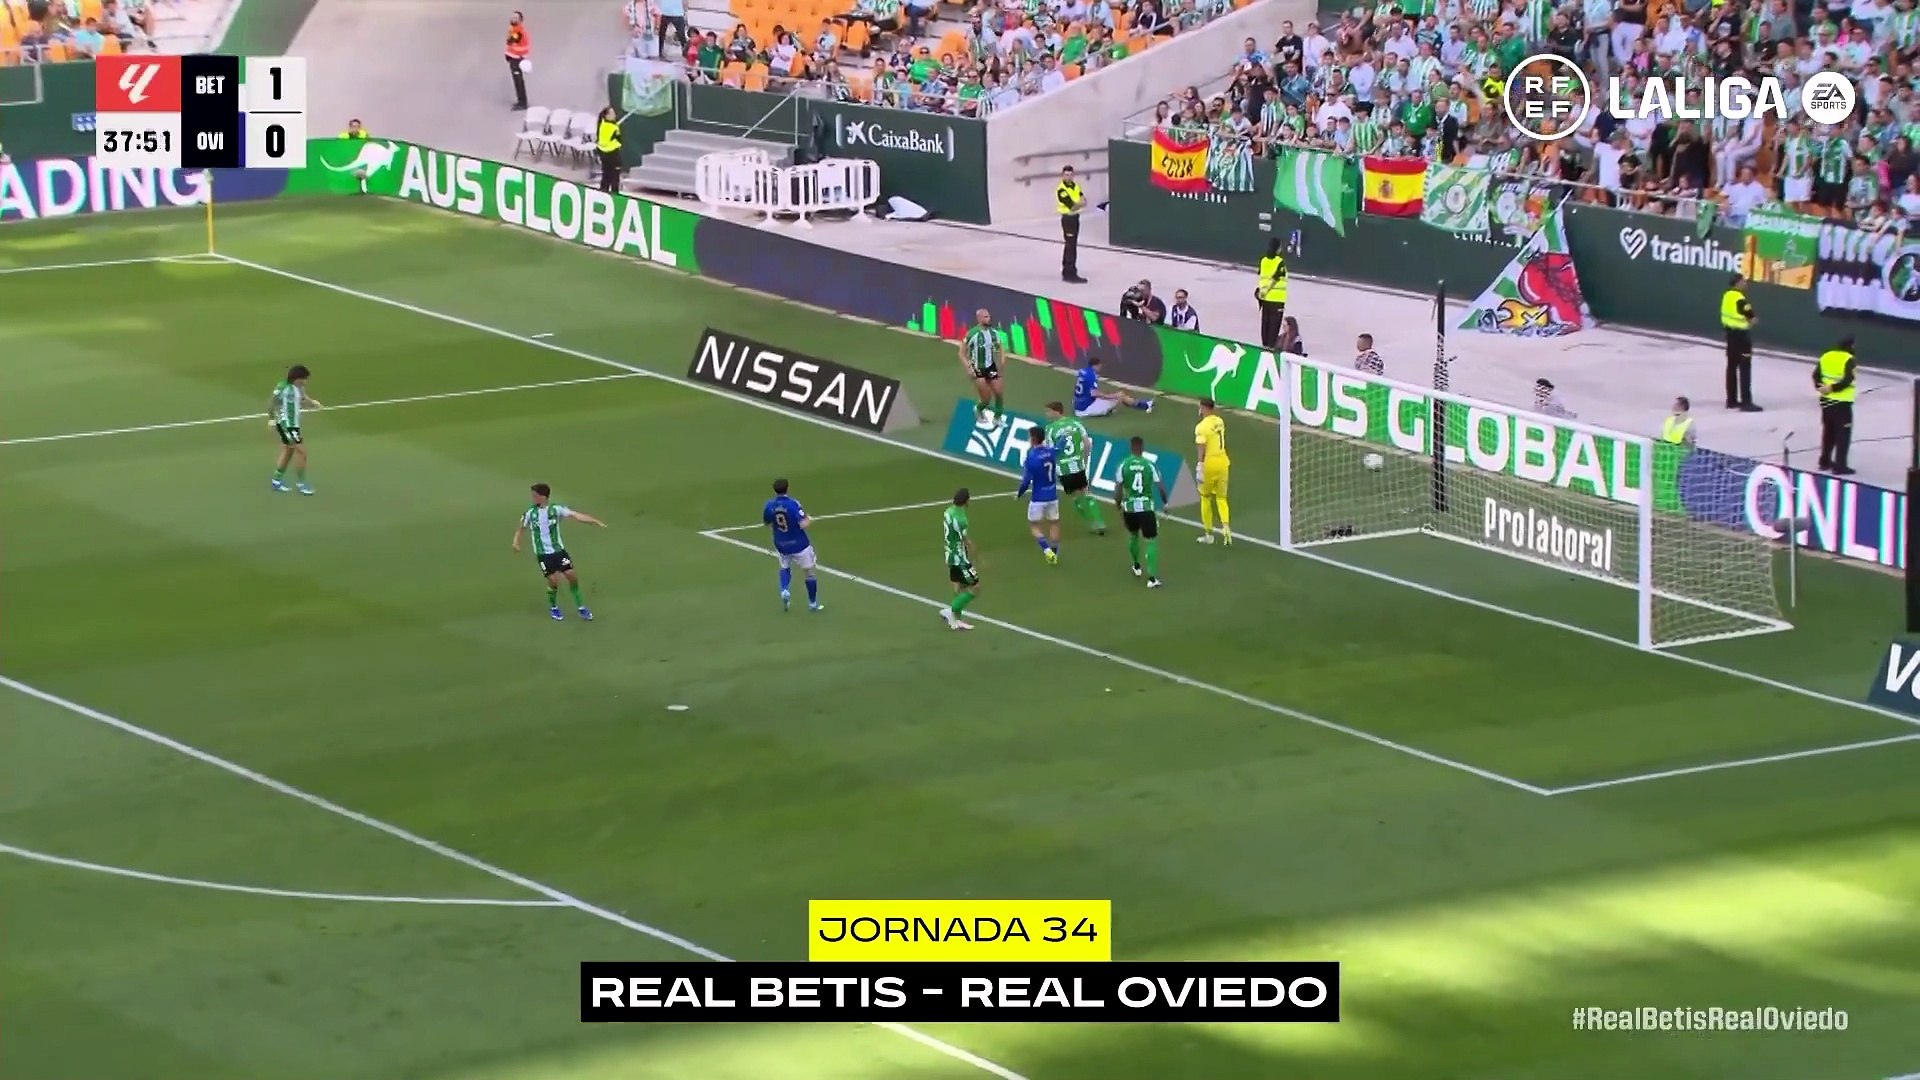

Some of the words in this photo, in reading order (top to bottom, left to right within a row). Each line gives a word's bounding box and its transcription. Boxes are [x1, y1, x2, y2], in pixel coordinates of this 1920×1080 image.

[868, 123, 944, 154] CaixaBank
[398, 146, 483, 215] AUS
[495, 166, 677, 267] GLOBAL
[1650, 236, 1744, 274] trainline
[695, 335, 892, 425] NISSAN
[1245, 350, 1369, 438] AUS
[1386, 392, 1645, 504] GLOBAL
[1043, 461, 1054, 482] 7
[1131, 471, 1144, 494] 4
[775, 512, 789, 533] 9
